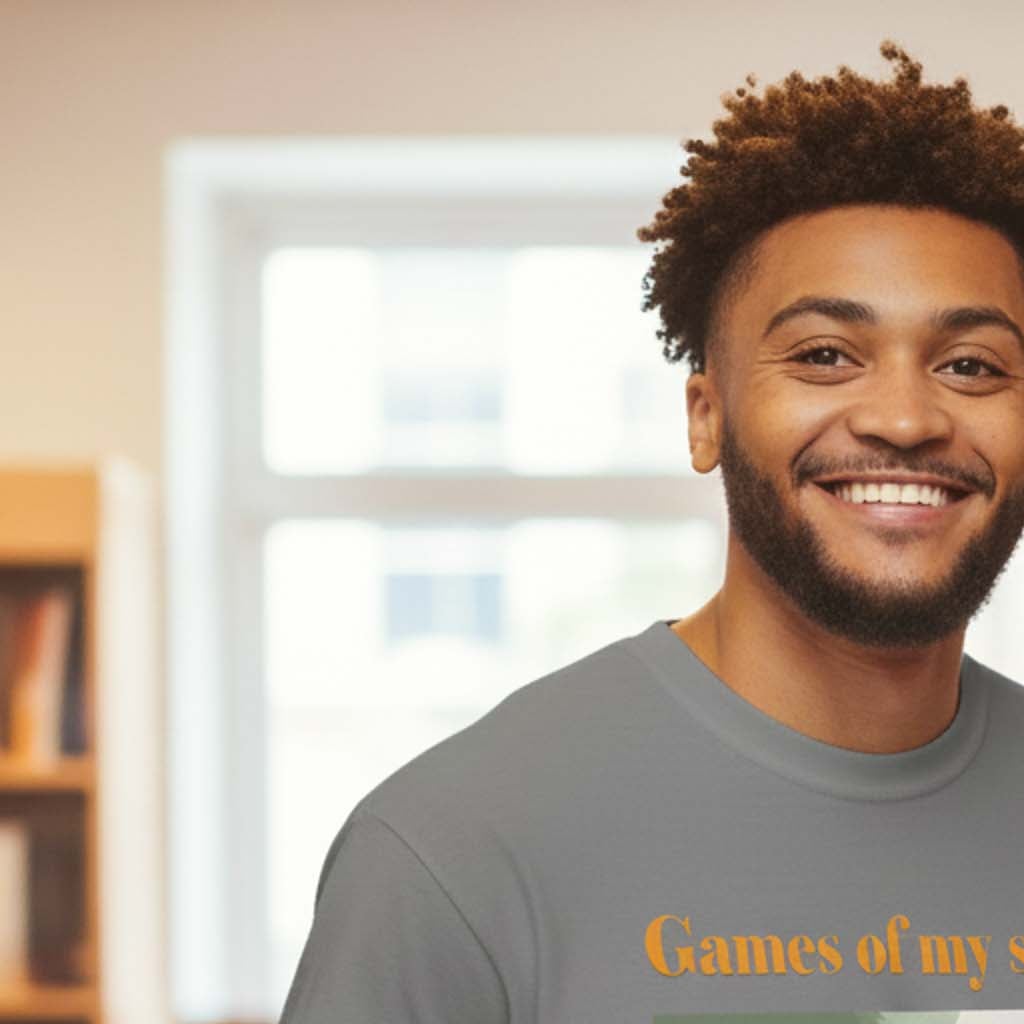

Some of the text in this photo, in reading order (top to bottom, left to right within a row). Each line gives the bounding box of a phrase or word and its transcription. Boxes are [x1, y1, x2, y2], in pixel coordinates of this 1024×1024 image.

[643, 914, 844, 977] Games
[857, 914, 911, 975] of
[919, 934, 991, 992] my
